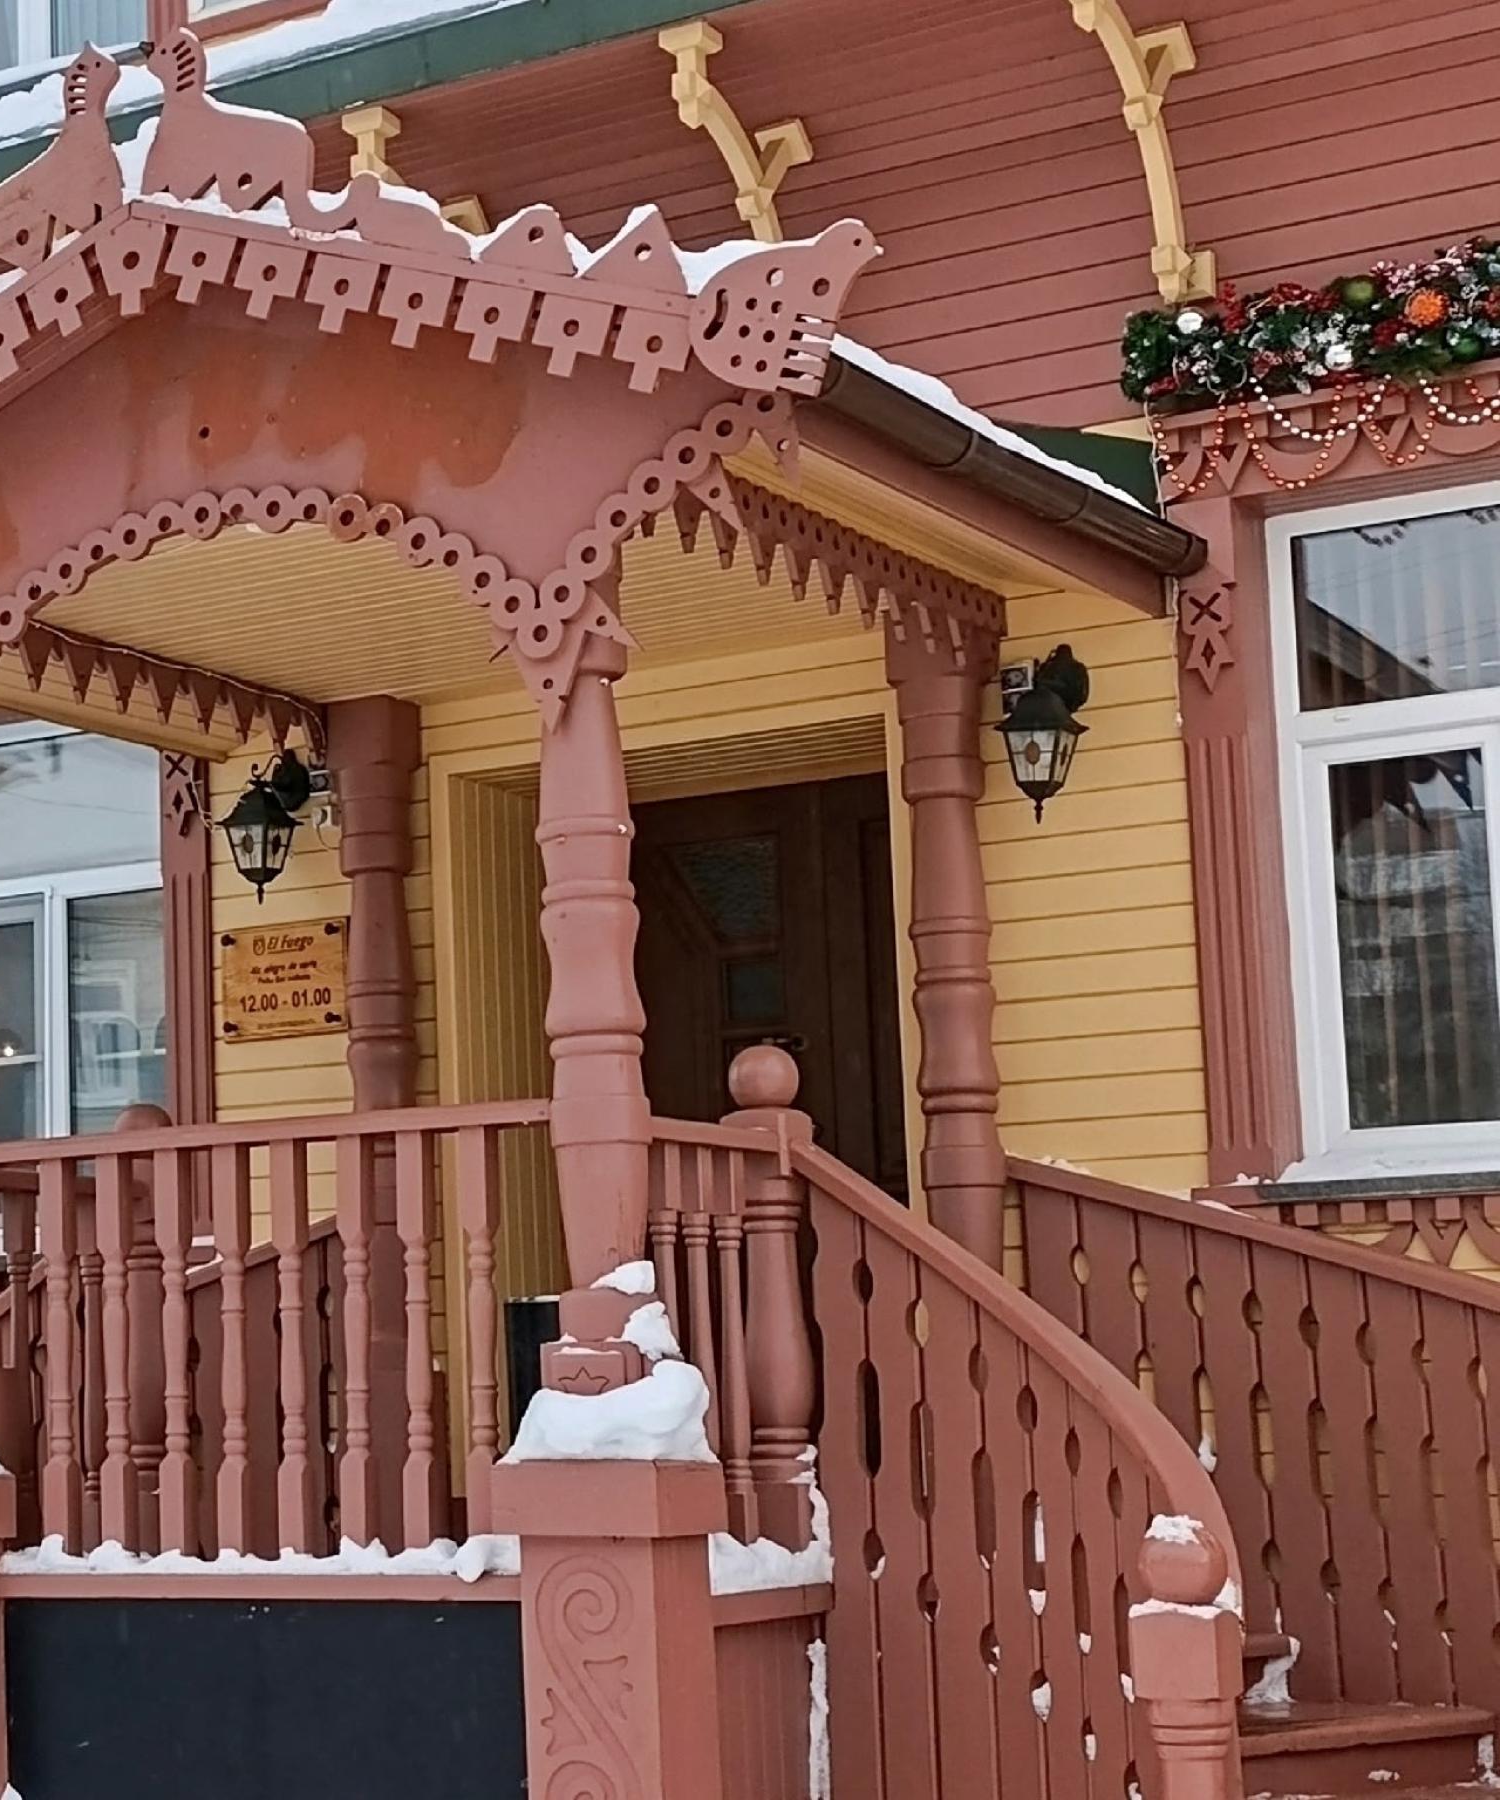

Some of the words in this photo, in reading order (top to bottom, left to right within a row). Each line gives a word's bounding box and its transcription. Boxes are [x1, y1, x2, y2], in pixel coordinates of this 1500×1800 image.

[267, 936, 279, 950] El
[281, 935, 314, 951] Fuego
[240, 993, 278, 1013] 12.00
[292, 987, 331, 1007] 01.00
